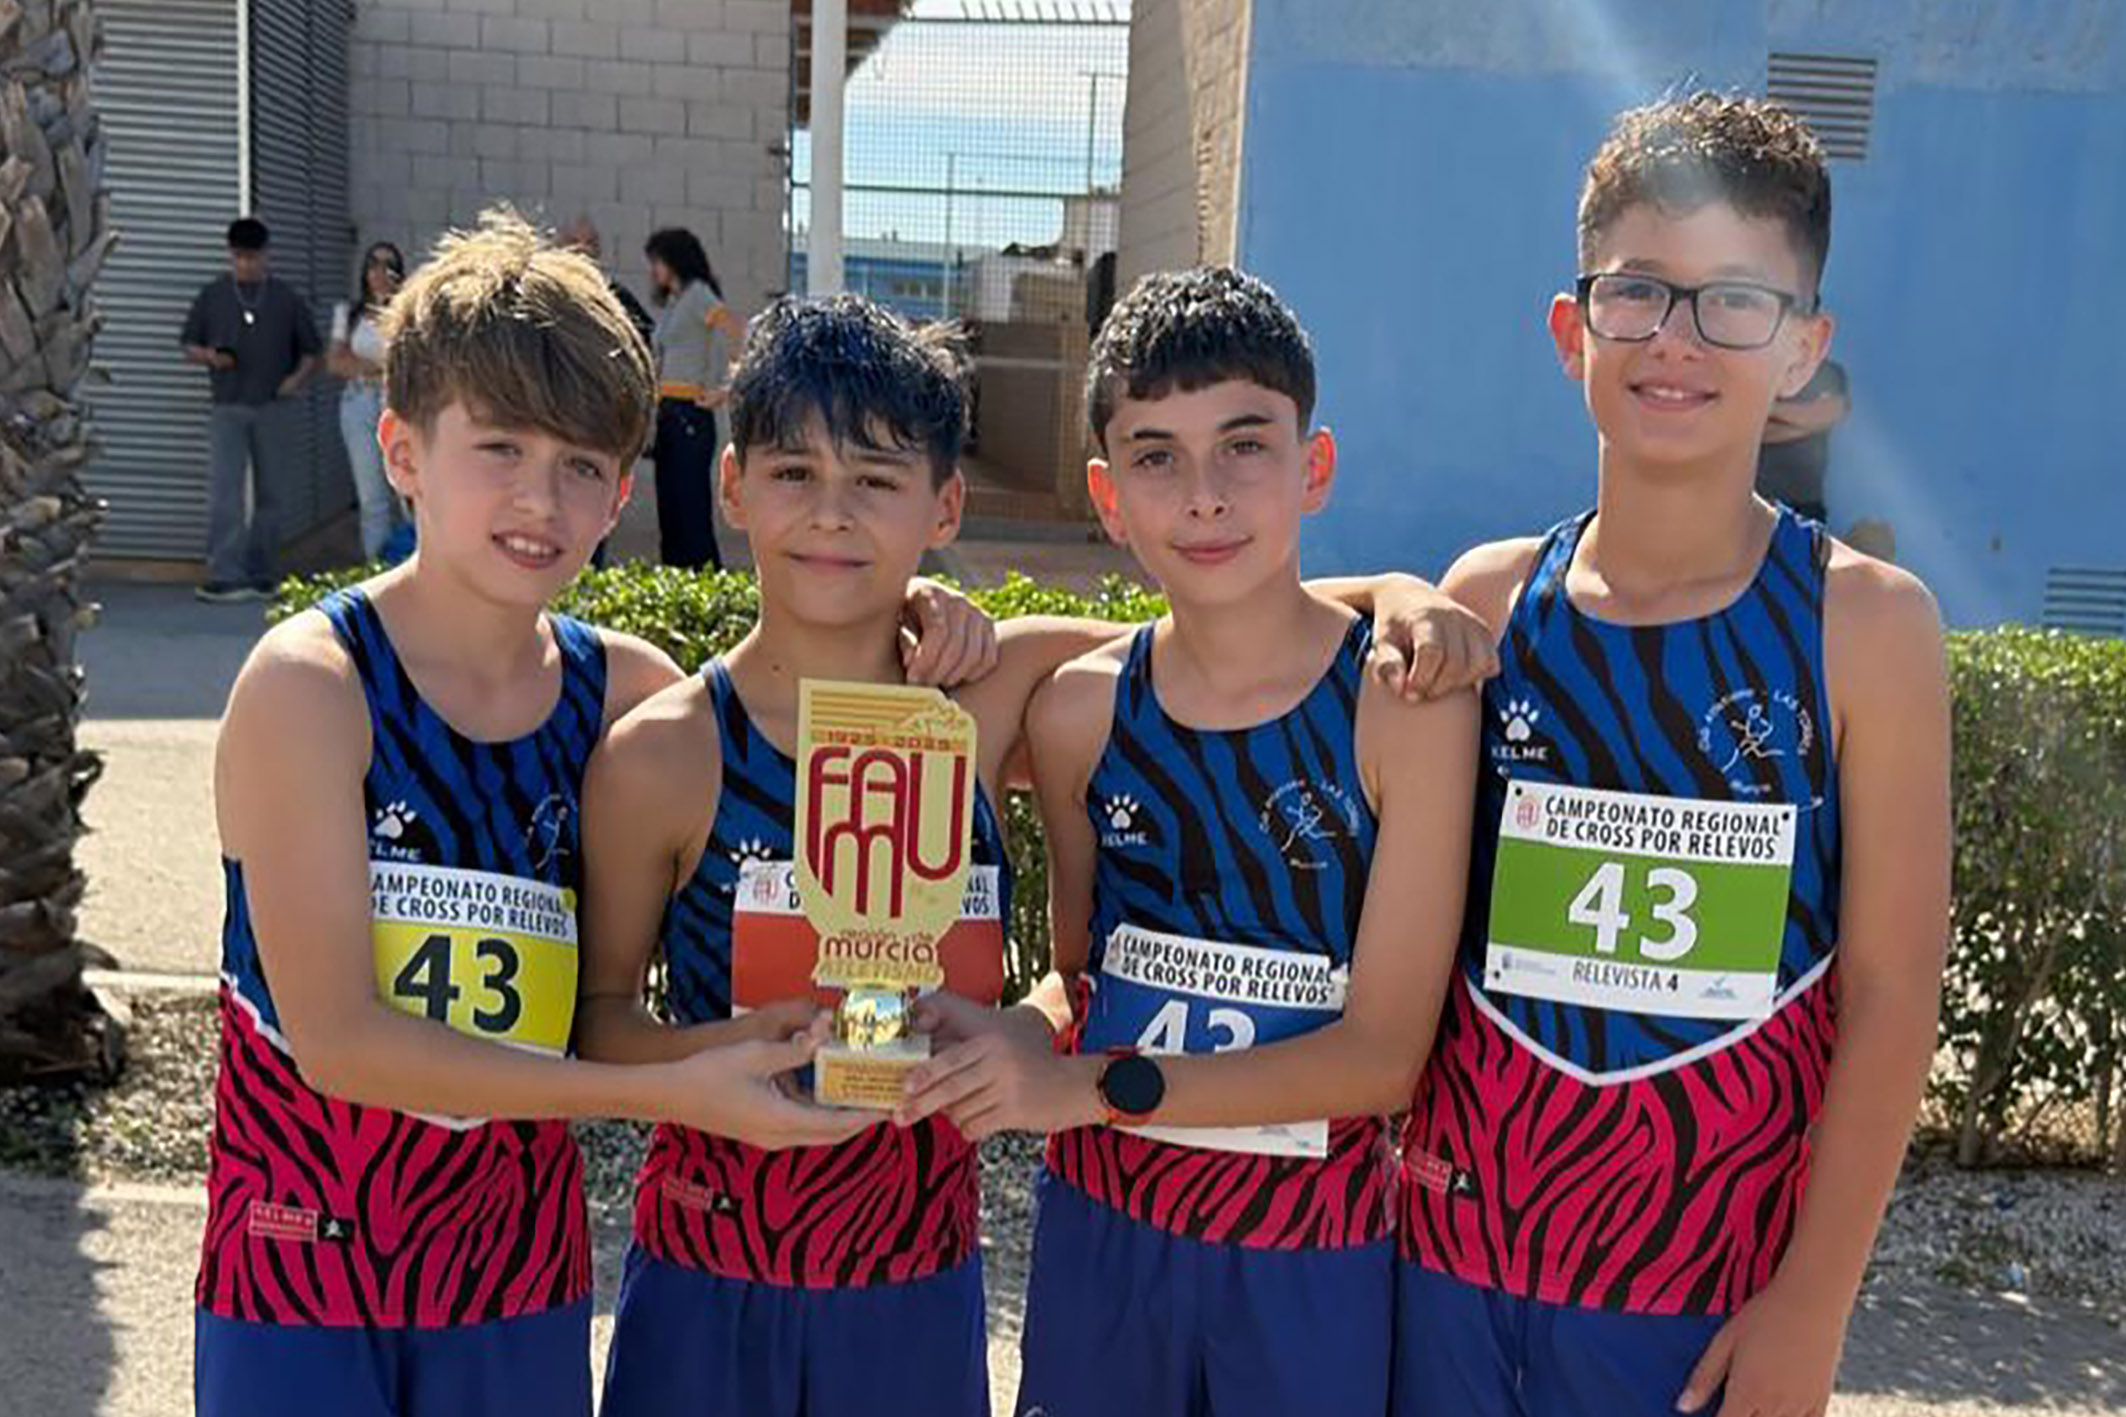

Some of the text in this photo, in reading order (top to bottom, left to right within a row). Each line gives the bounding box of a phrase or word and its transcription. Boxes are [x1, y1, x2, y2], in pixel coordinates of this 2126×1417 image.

[1546, 795, 1674, 829] CAMPEONATO
[1682, 810, 1781, 836] REGIONAL
[1546, 818, 1776, 860] DE CROSS POR RELEVOS
[371, 873, 566, 917] AMPEONATO REGIONA
[1568, 861, 1699, 962] 43
[397, 896, 460, 921] CROSS
[467, 903, 504, 927] POR
[507, 908, 568, 938] RELEVOS
[825, 937, 934, 963] murcia
[1124, 934, 1236, 974] CAMPEONATO
[394, 934, 522, 1034] 43
[1143, 961, 1199, 990] CROSS
[1203, 972, 1241, 997] POR
[1247, 977, 1329, 1006] RELEVOS
[1573, 961, 1662, 991] RELEVISTA
[1667, 973, 1680, 992] 4
